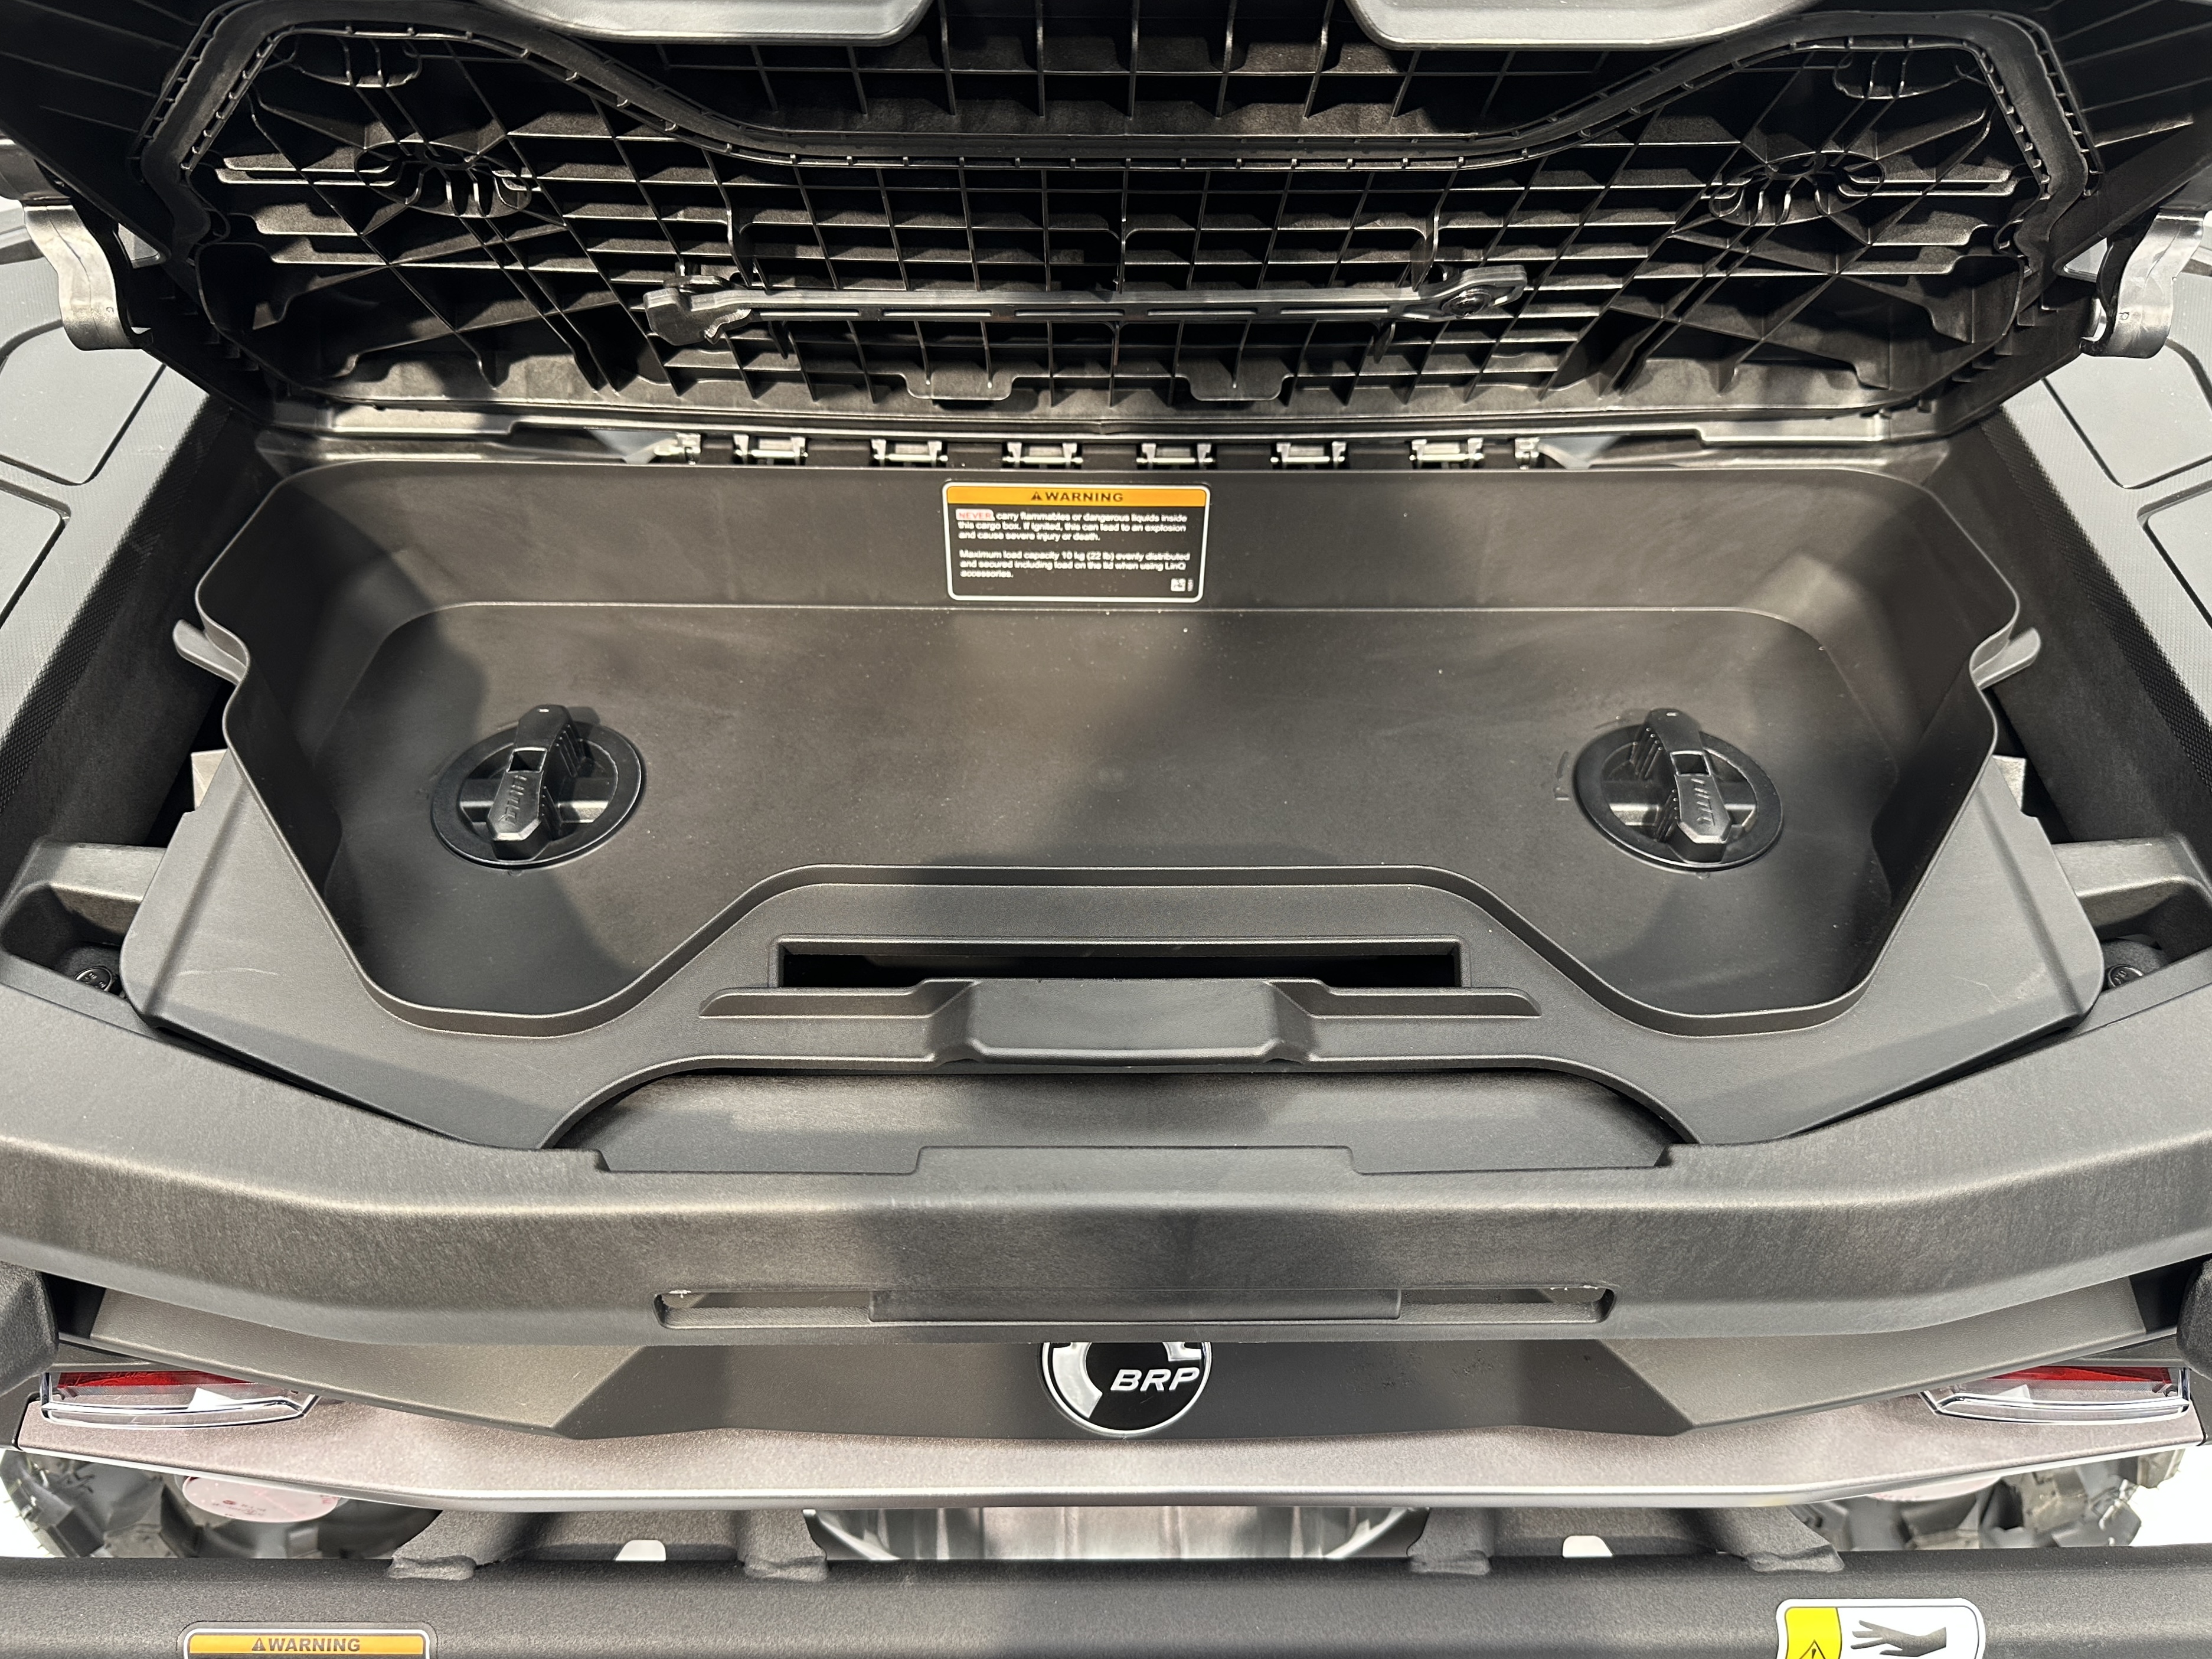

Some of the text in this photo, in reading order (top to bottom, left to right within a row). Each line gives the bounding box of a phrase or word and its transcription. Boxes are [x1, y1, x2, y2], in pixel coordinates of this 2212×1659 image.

[1045, 492, 1123, 502] WARNING
[996, 512, 1019, 521] carry
[1020, 511, 1070, 521] flammables
[1083, 512, 1130, 522] dangerous
[1131, 512, 1159, 523] liquids
[1161, 513, 1188, 522] inside
[958, 521, 975, 530] this
[975, 522, 1001, 531] cargo
[1002, 522, 1021, 530] box.
[1100, 522, 1120, 531] lead
[1131, 523, 1143, 531] an
[1144, 523, 1187, 533] explosion
[1036, 532, 1061, 542] injury
[1072, 533, 1100, 541] death.
[959, 550, 1002, 559] Maximum
[1003, 550, 1022, 559] load
[1023, 551, 1060, 560] capacity
[1061, 551, 1073, 559] 10
[1074, 551, 1086, 561] kg
[1087, 551, 1101, 561] (22
[1115, 552, 1144, 561] evenly
[1145, 552, 1191, 561] distributed
[978, 560, 1013, 569] secured
[1014, 560, 1053, 570] including
[1053, 561, 1073, 569] load
[1087, 561, 1102, 570] the
[1102, 561, 1115, 570] lid
[1115, 561, 1139, 570] when
[1139, 562, 1164, 571] using
[1164, 562, 1187, 570] LinQ
[960, 570, 1014, 578] accessories.
[1110, 1367, 1200, 1392] BRP
[268, 1638, 360, 1652] WARNING
